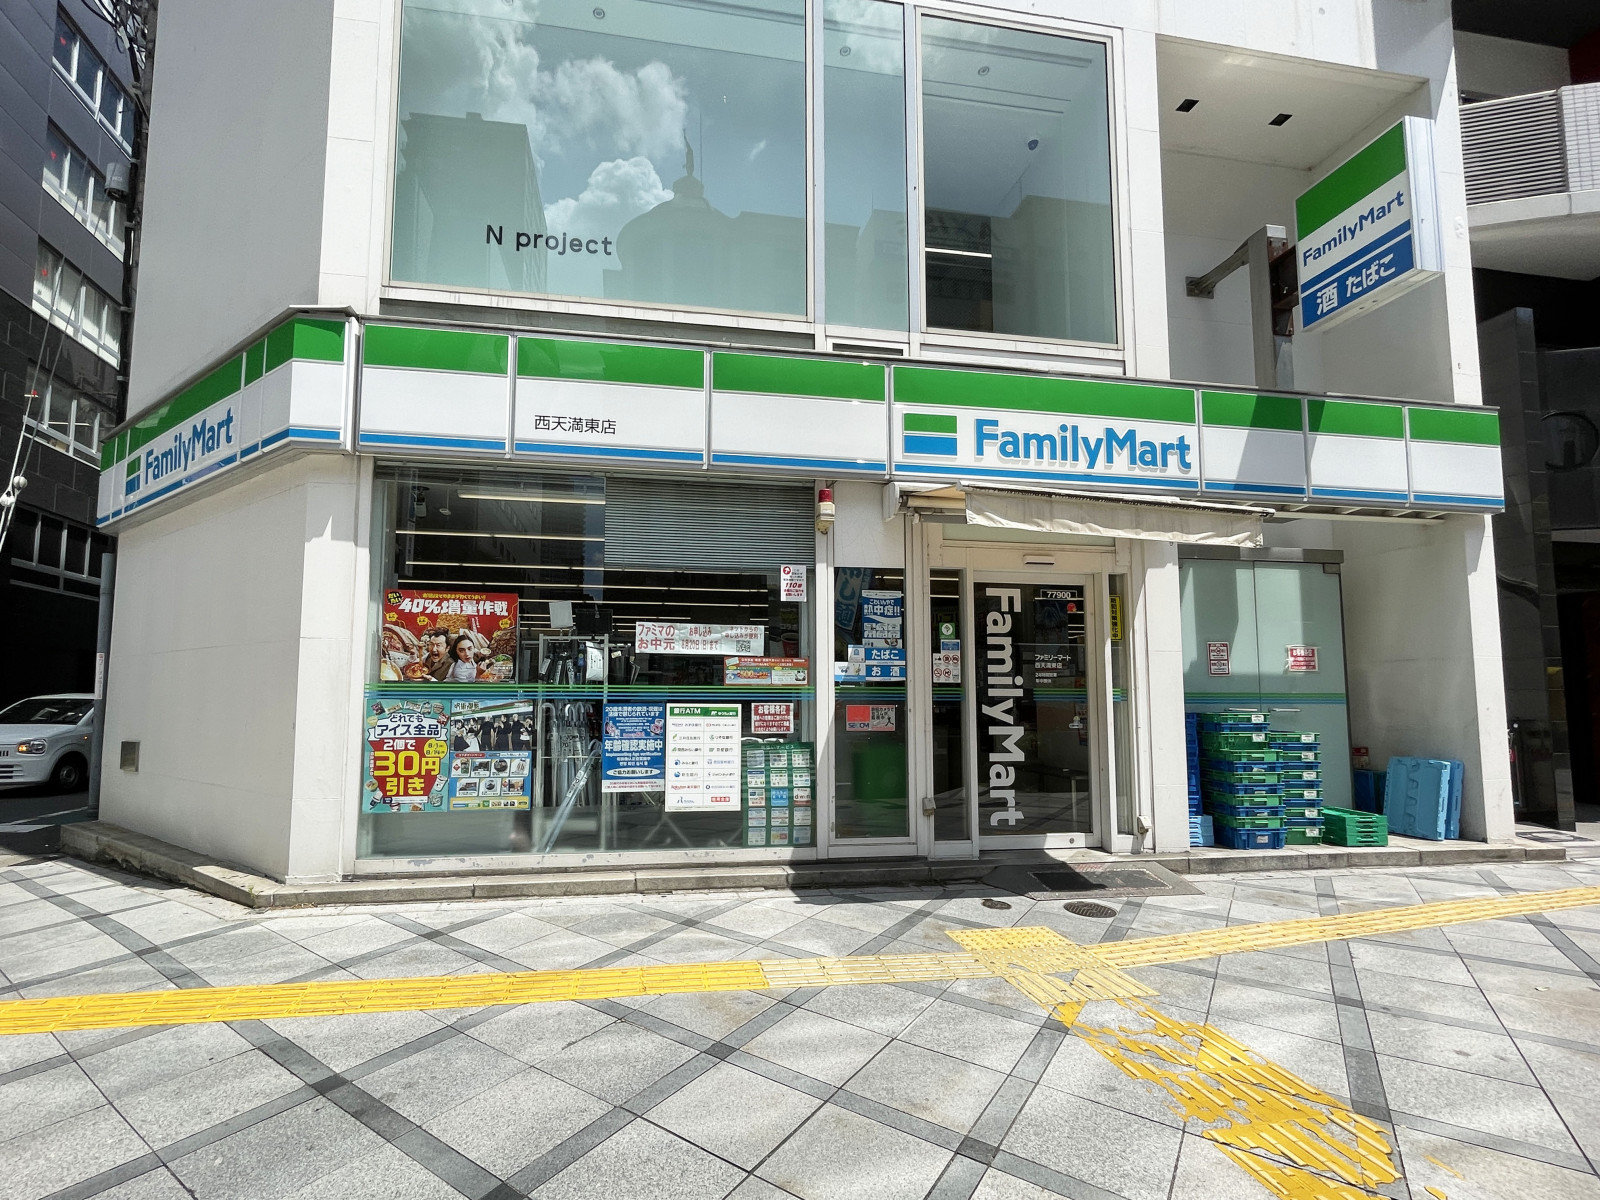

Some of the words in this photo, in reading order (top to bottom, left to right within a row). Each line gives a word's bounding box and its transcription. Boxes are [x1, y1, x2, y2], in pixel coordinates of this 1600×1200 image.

[1303, 190, 1404, 267] FamilyMart
[486, 225, 503, 245] N
[515, 230, 612, 256] project
[1316, 281, 1339, 316] 酒
[1346, 253, 1396, 299] たばこ
[534, 415, 617, 434] 西天満東店
[145, 407, 234, 485] FamilyMart
[975, 419, 1191, 471] FamilyMart
[1046, 591, 1071, 599] 77900
[398, 598, 509, 616] 40%増量作戦
[863, 605, 900, 616] 熱中症!!
[638, 624, 675, 637] ファミマの
[689, 626, 712, 637] お申し込み
[637, 637, 675, 651] お中元
[871, 649, 899, 659] たばこ
[981, 587, 1026, 827] FamilyMart
[389, 714, 424, 723] どれでも
[377, 724, 440, 736] アイス全品
[383, 739, 416, 751] 2個で
[604, 739, 663, 751] 年齢確認実施中
[373, 750, 440, 776] 30円
[386, 777, 425, 796] 引き
